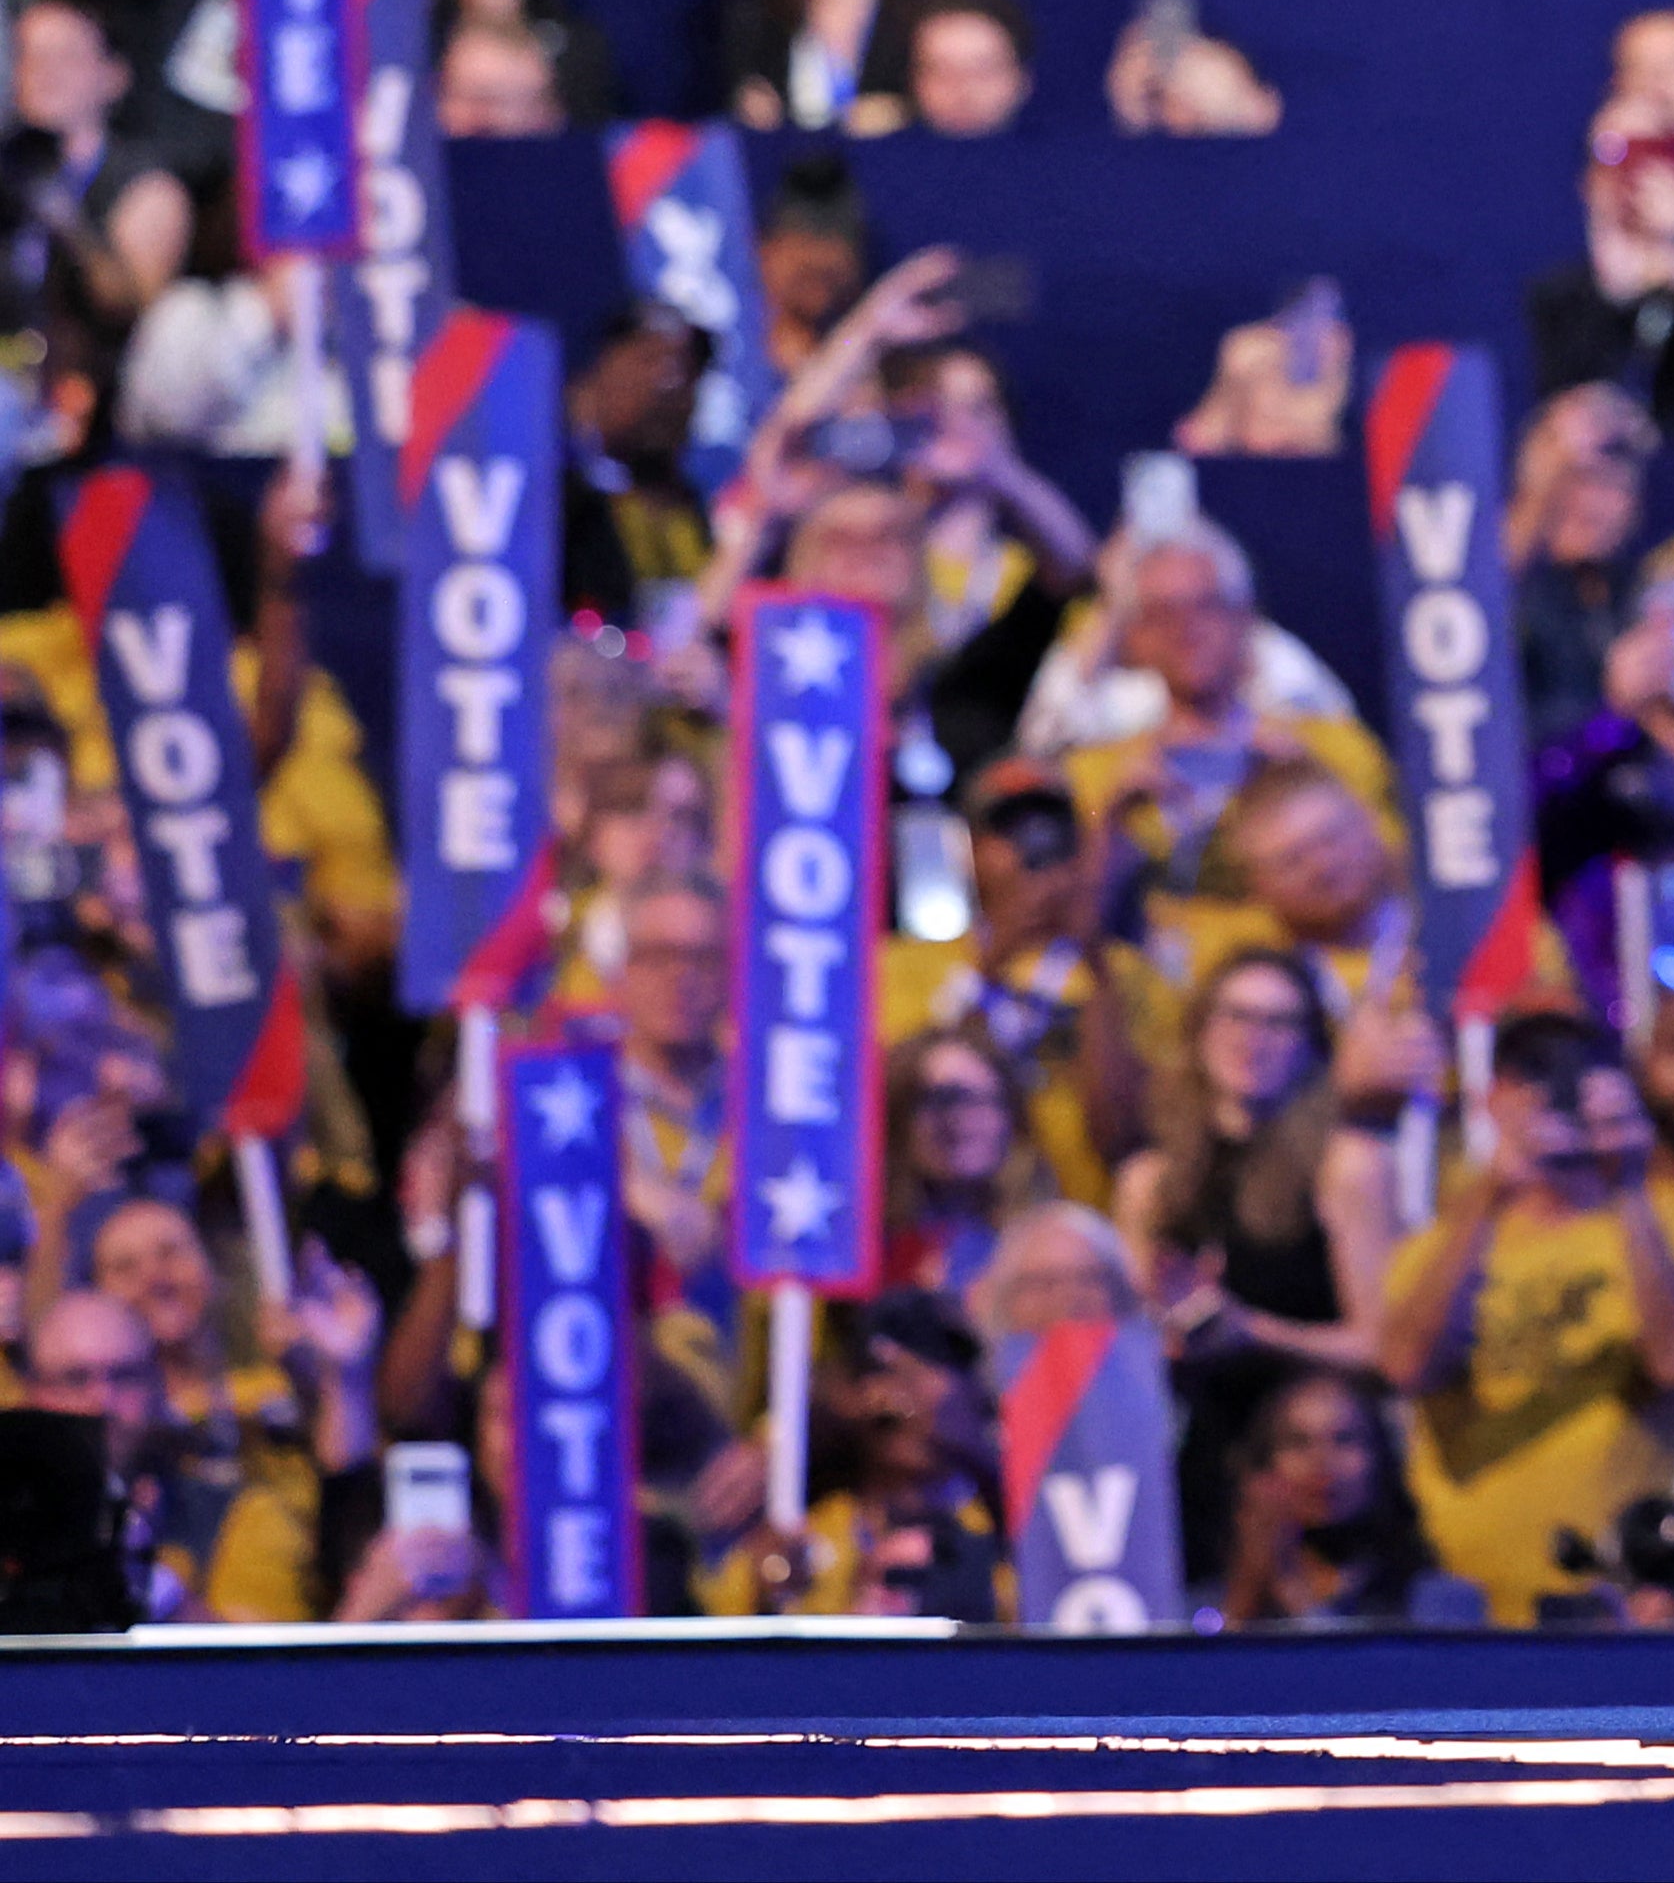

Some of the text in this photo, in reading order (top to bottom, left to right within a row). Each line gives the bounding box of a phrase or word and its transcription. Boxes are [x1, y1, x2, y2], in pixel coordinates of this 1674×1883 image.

[104, 603, 258, 1009] VOTE
[432, 455, 526, 872] VOTE
[1398, 485, 1499, 887] VOTE
[761, 722, 854, 1124] VOTE
[530, 1191, 614, 1607] VOTE
